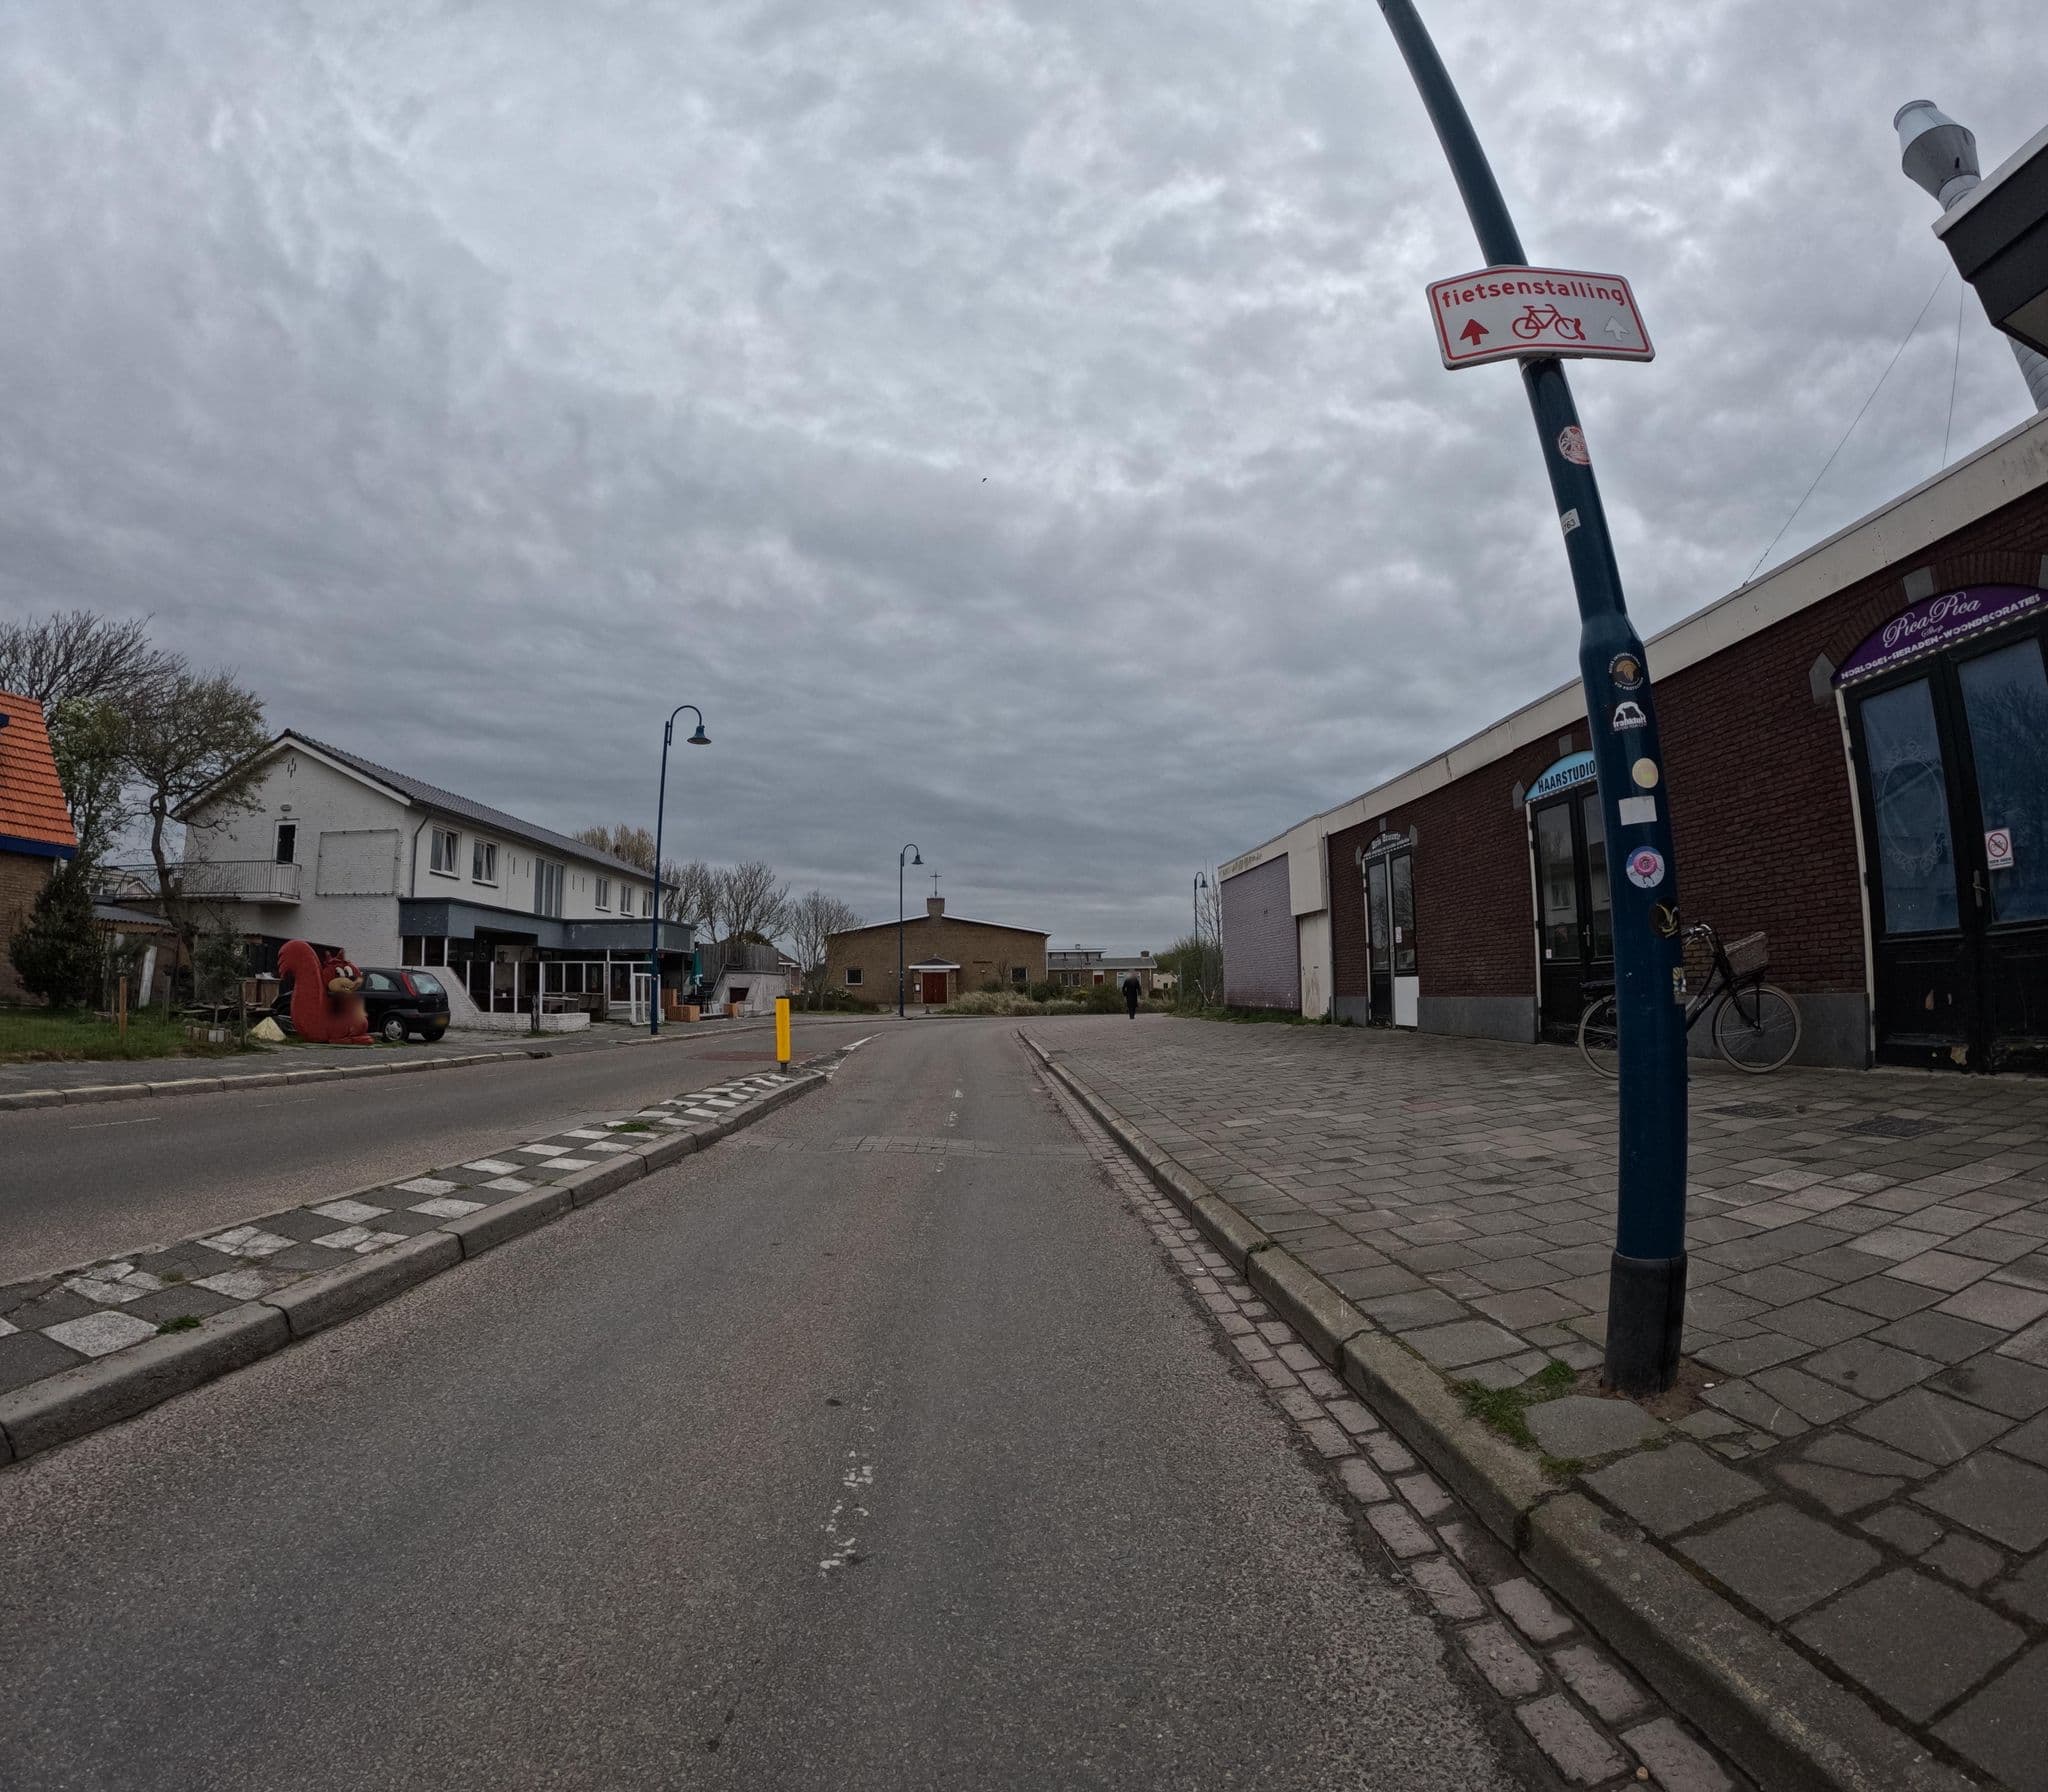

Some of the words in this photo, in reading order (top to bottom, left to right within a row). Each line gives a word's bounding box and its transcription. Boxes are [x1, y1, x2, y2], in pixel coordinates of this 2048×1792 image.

[1442, 279, 1626, 308] fietsenstalling
[1882, 611, 1931, 649] Pica
[1928, 591, 1982, 625] Pica
[1537, 759, 1596, 793] HAARSTUDIO
